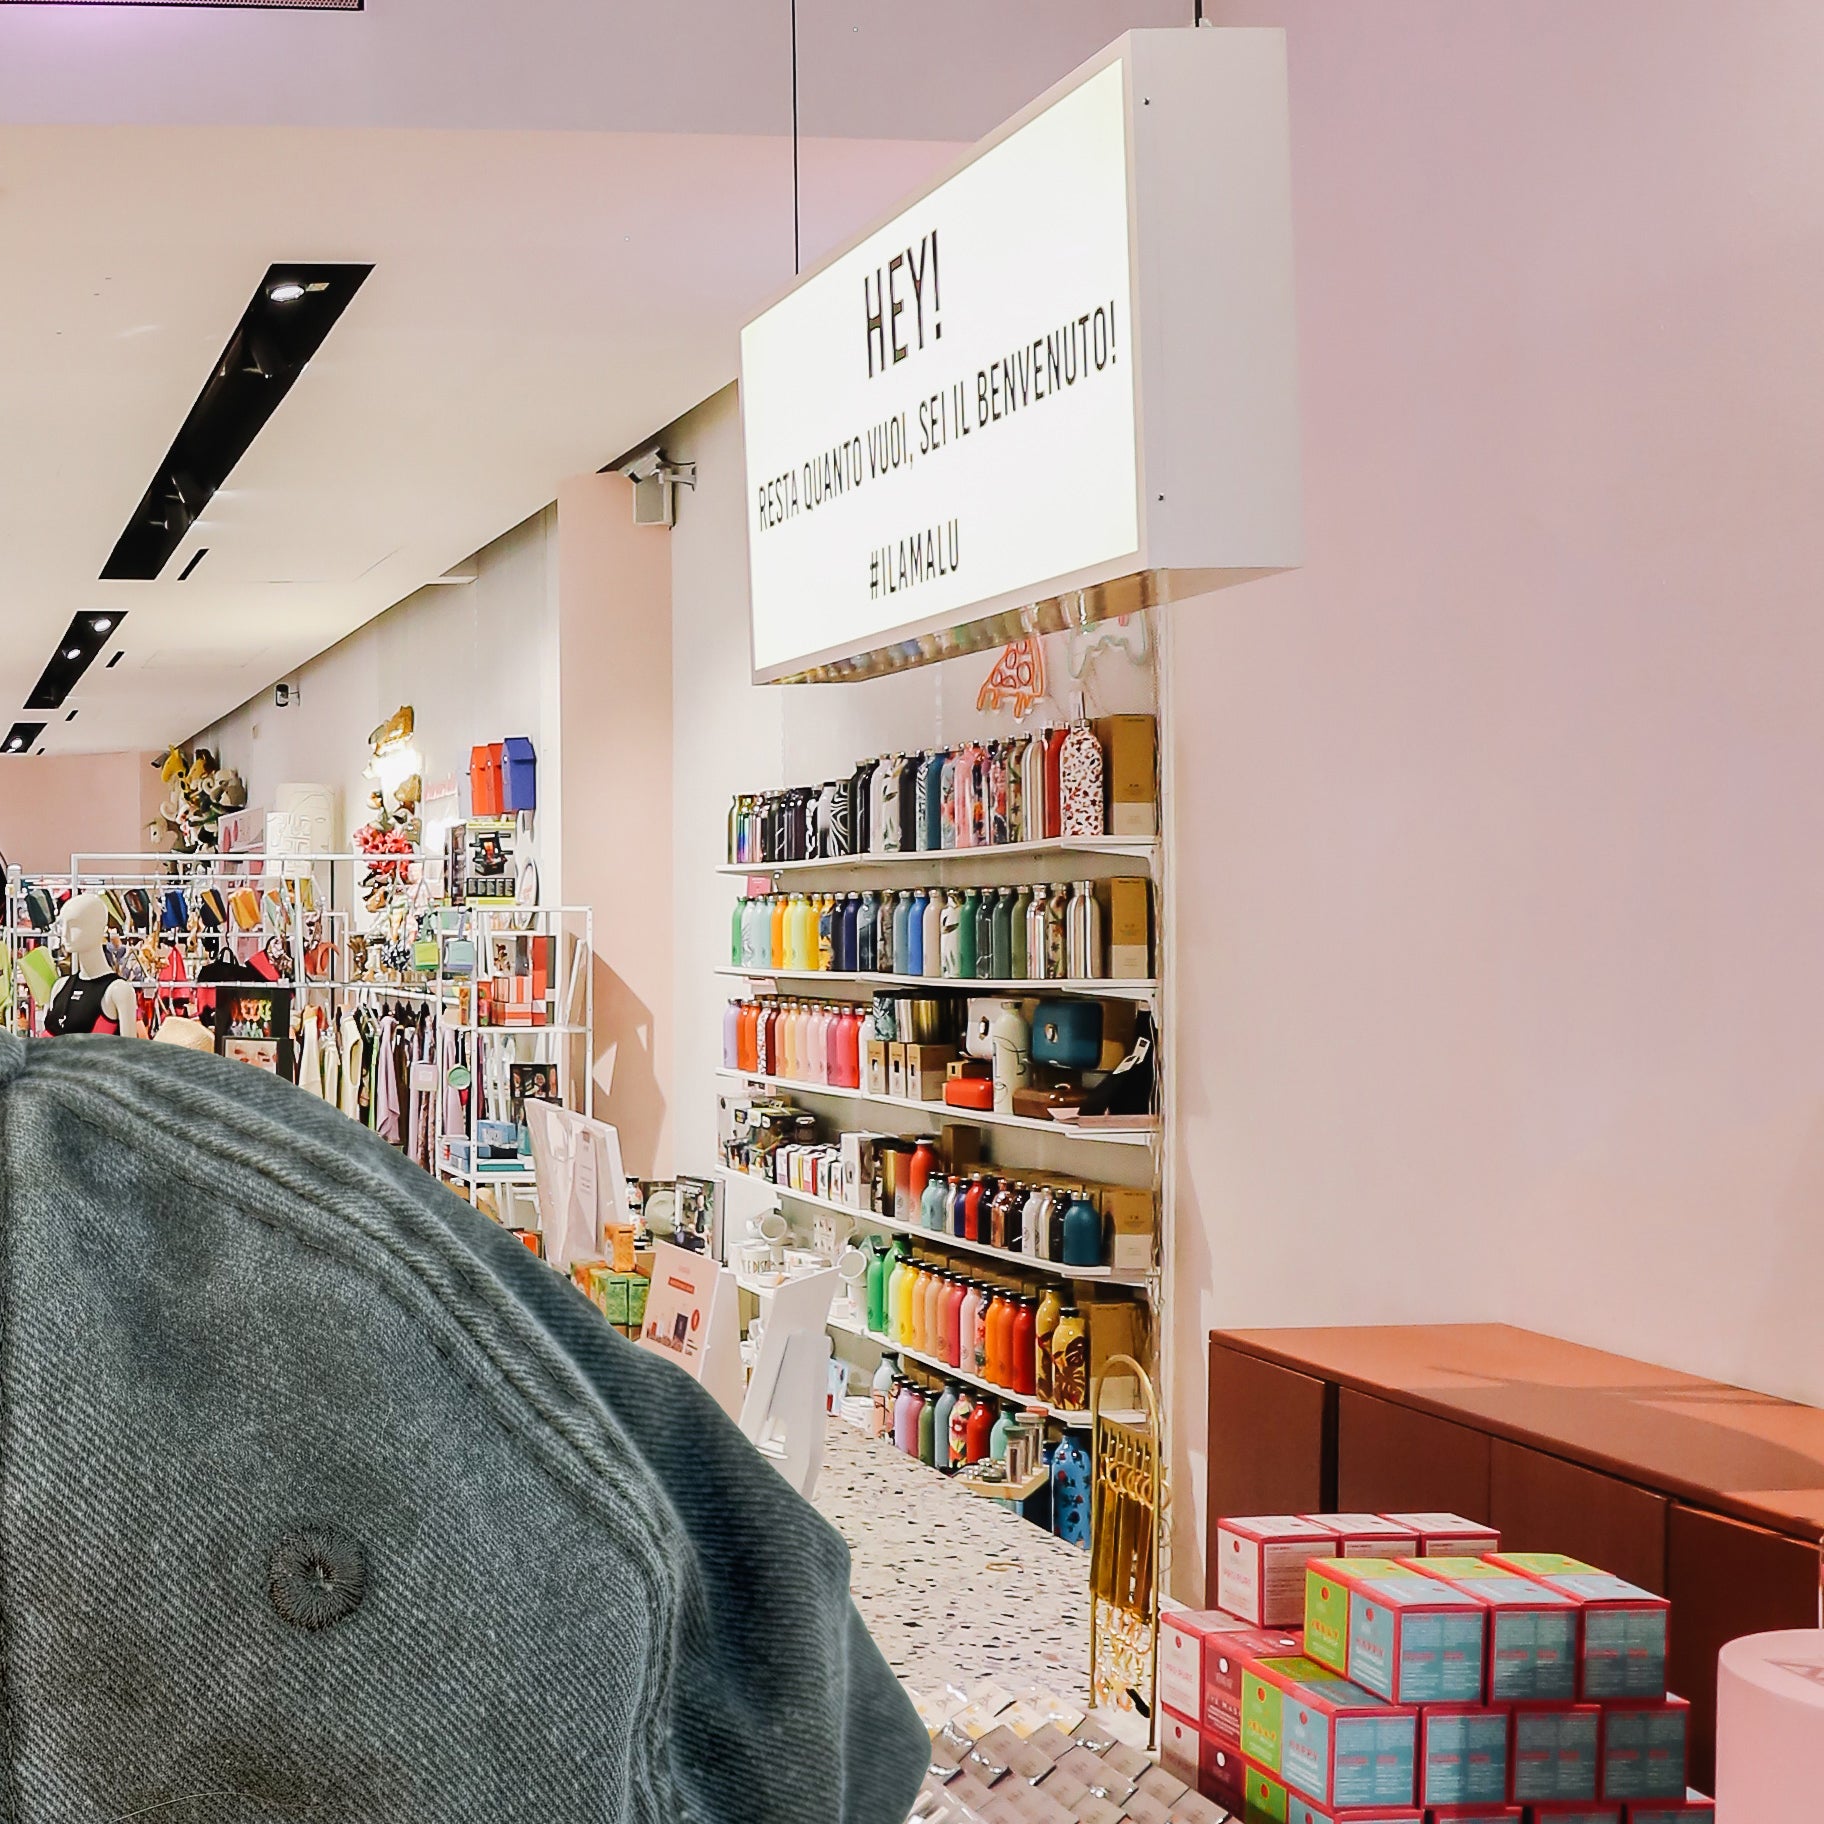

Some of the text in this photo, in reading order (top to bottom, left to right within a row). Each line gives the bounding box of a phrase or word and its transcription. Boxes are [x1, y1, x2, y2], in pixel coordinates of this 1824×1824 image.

[864, 228, 942, 379] HEY!
[758, 299, 1117, 532] RESTA QUANTO VUOI, SEI IL BENVENUTO!
[869, 517, 960, 600] #ILAMALU
